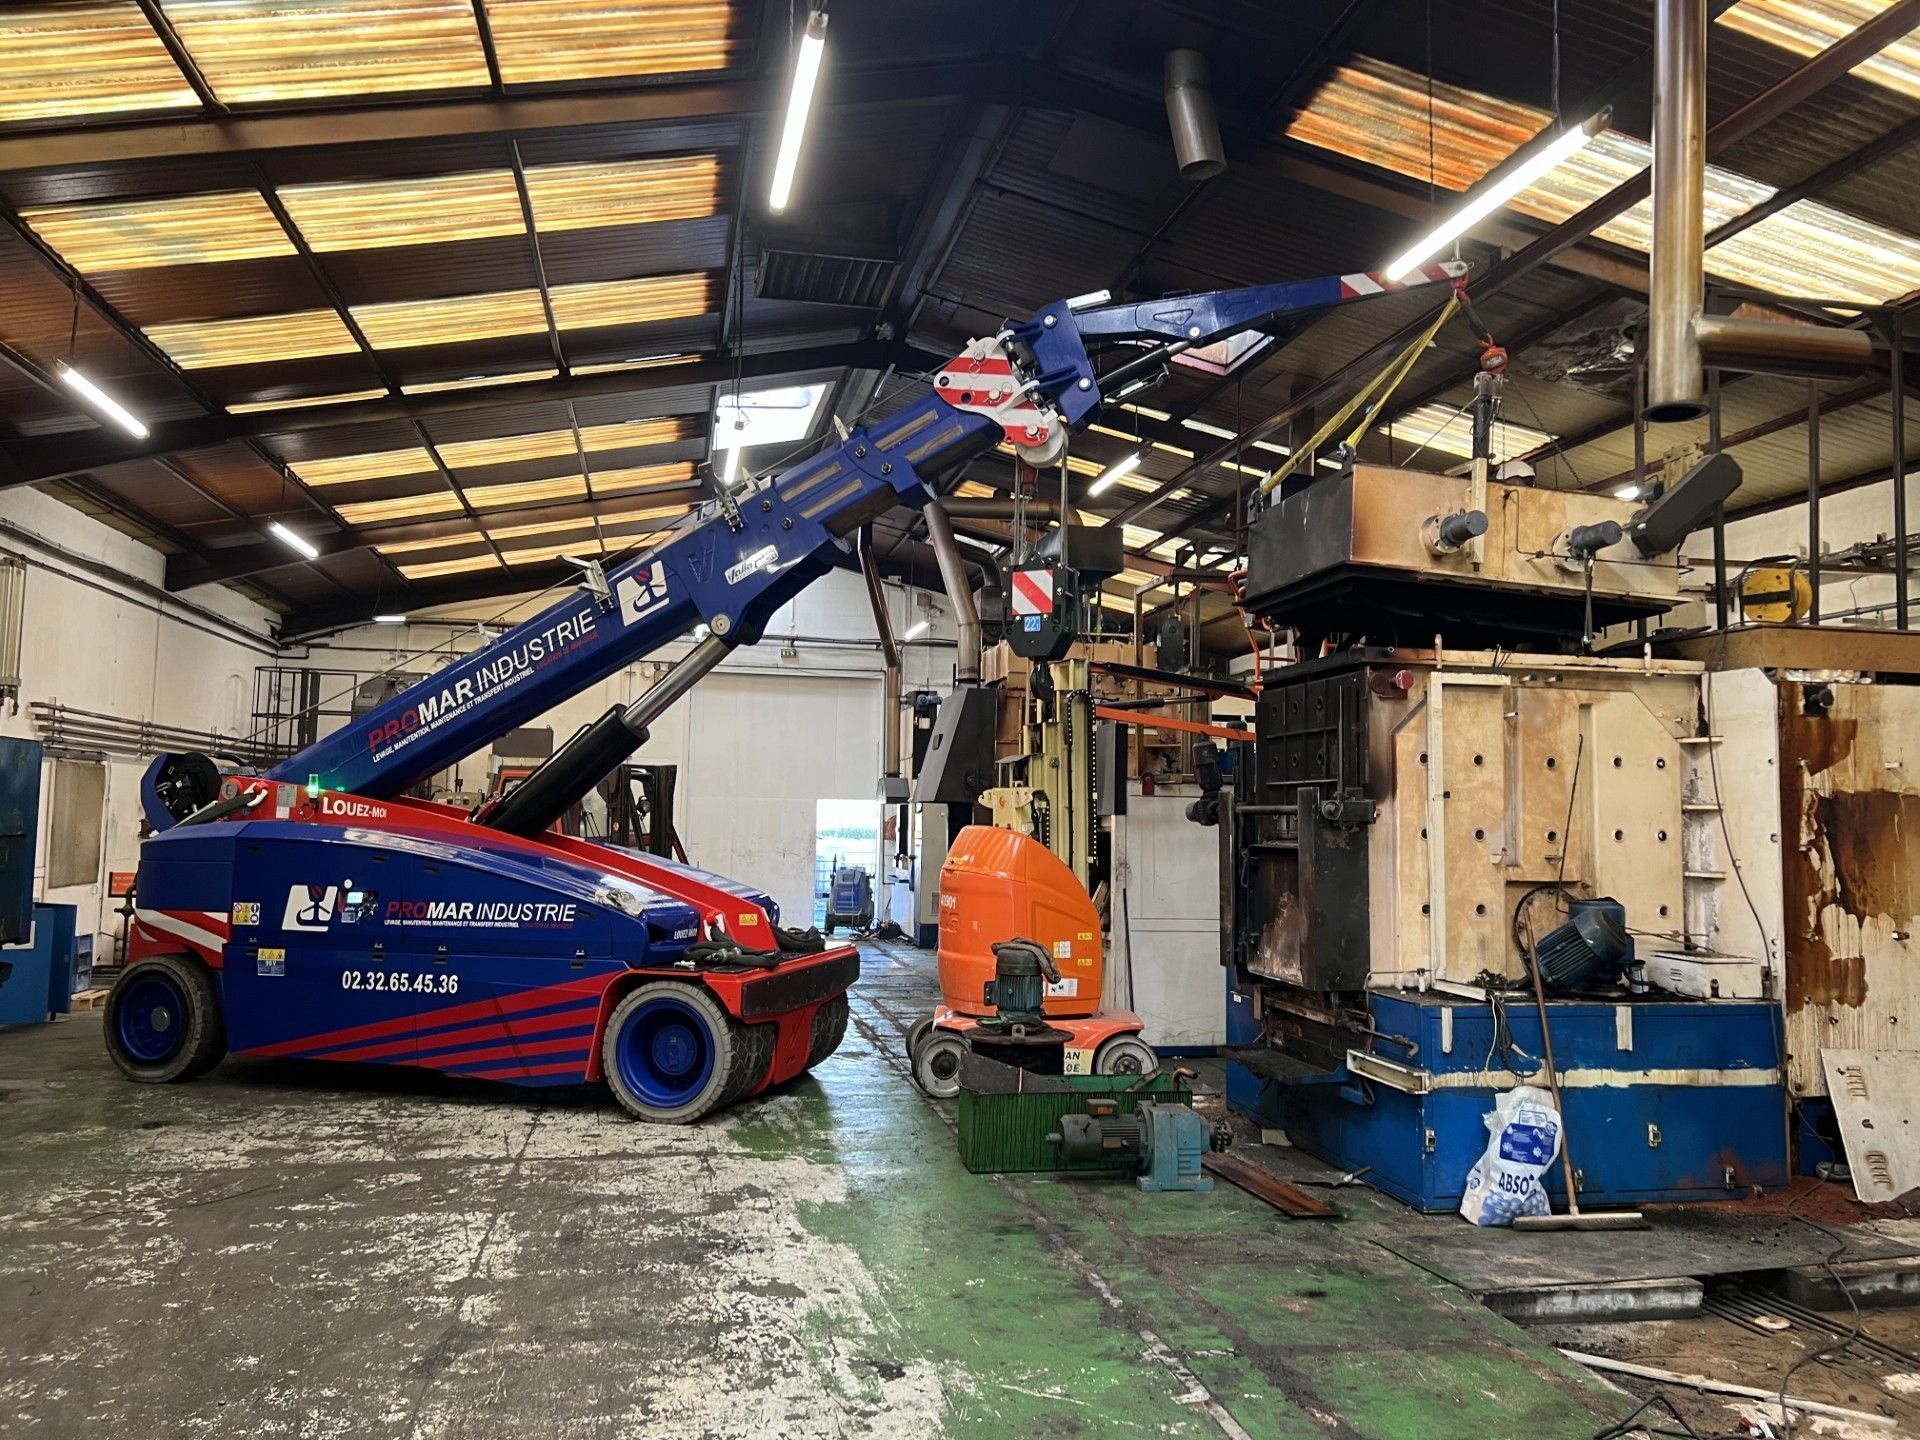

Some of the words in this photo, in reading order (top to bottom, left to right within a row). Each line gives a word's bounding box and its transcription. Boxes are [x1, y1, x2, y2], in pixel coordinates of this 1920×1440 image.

[368, 678, 474, 752] PROMAR
[476, 608, 596, 692] INDUSTRIE
[394, 727, 430, 750] MANUTENTION,
[430, 705, 466, 729] MAINTENANCE
[466, 702, 474, 710] ET
[474, 685, 504, 706] TRANSFERT
[505, 667, 535, 688] INDUSTRIEL
[322, 797, 387, 818] LOUEZ-MOI
[386, 900, 474, 920] PROMAR
[476, 902, 577, 922] INDUSTRIE
[342, 970, 458, 994] 02.32.65.45.36
[1064, 1051, 1081, 1060] AN
